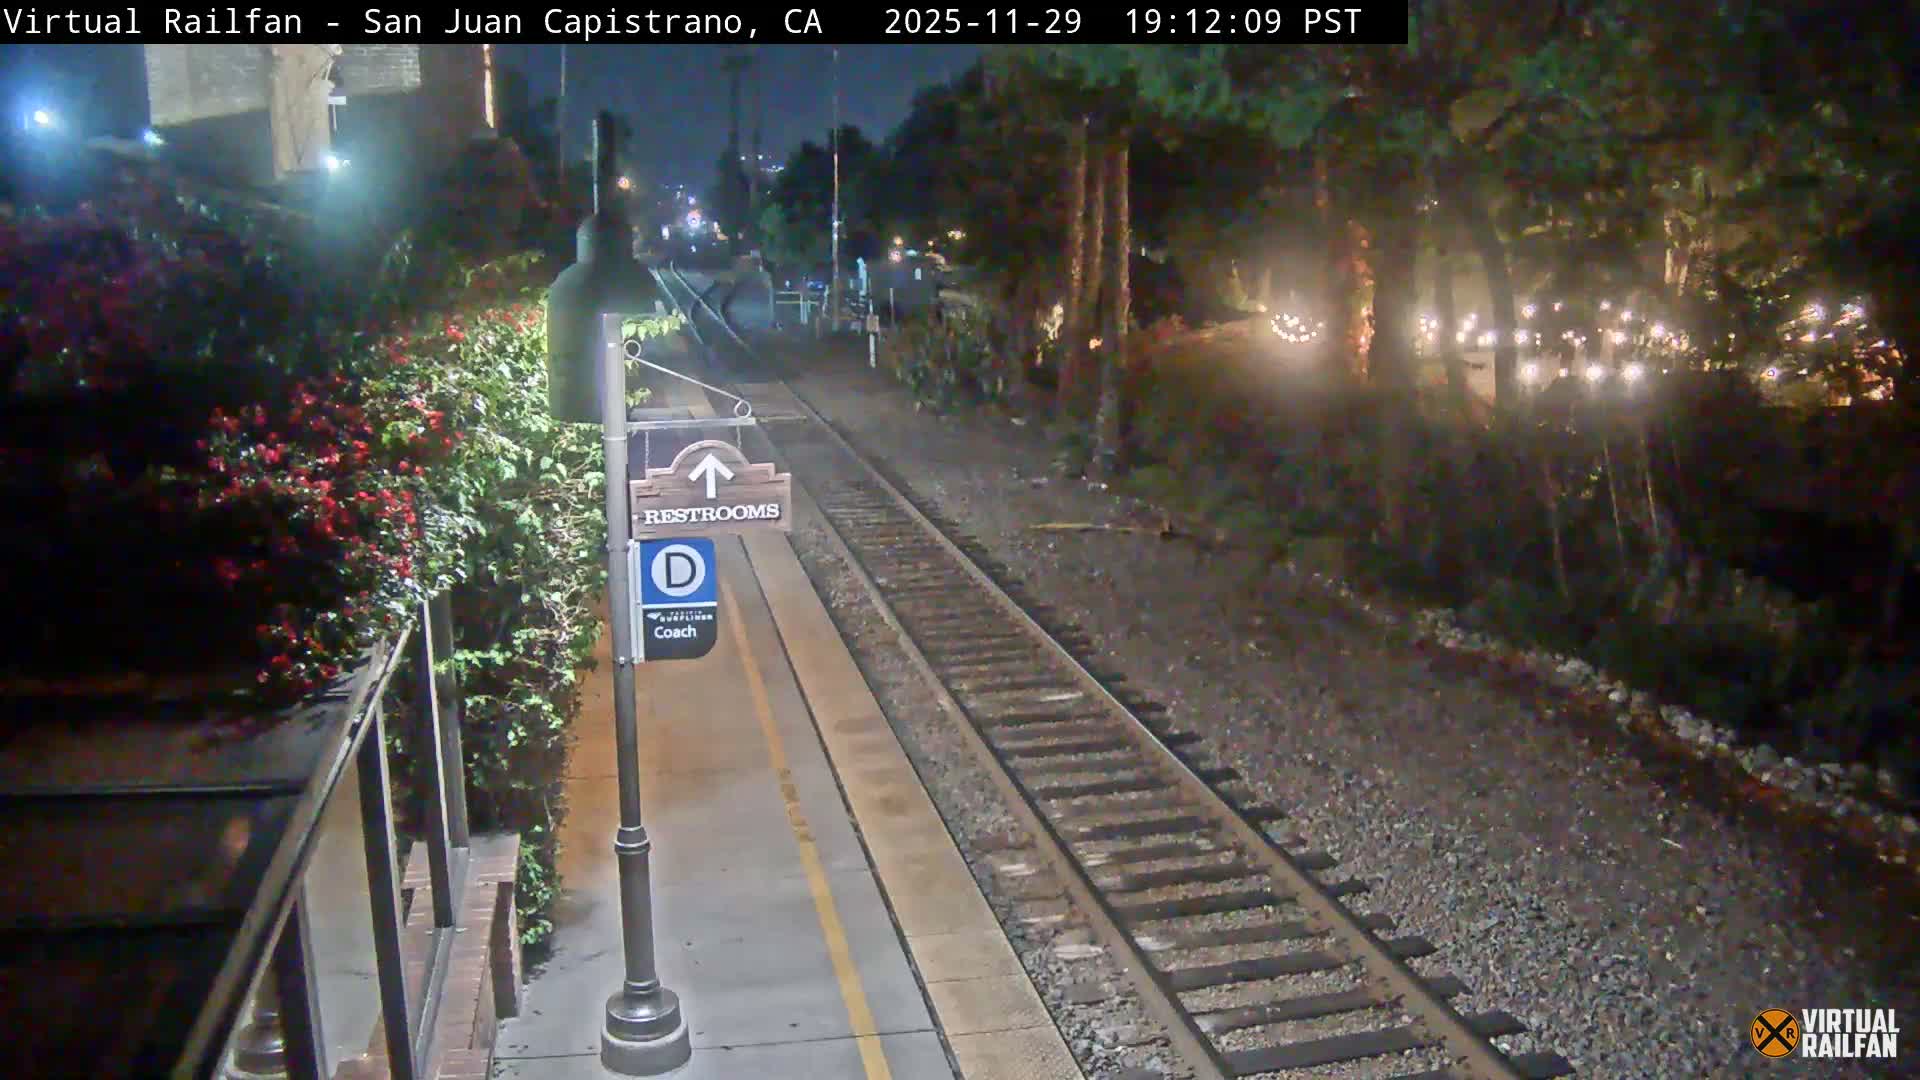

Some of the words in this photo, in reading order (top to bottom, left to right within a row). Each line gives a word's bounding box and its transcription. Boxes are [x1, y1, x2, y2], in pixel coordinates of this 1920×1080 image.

[643, 504, 780, 525] RESTROOMS
[665, 552, 697, 588] D
[654, 624, 697, 639] Coach
